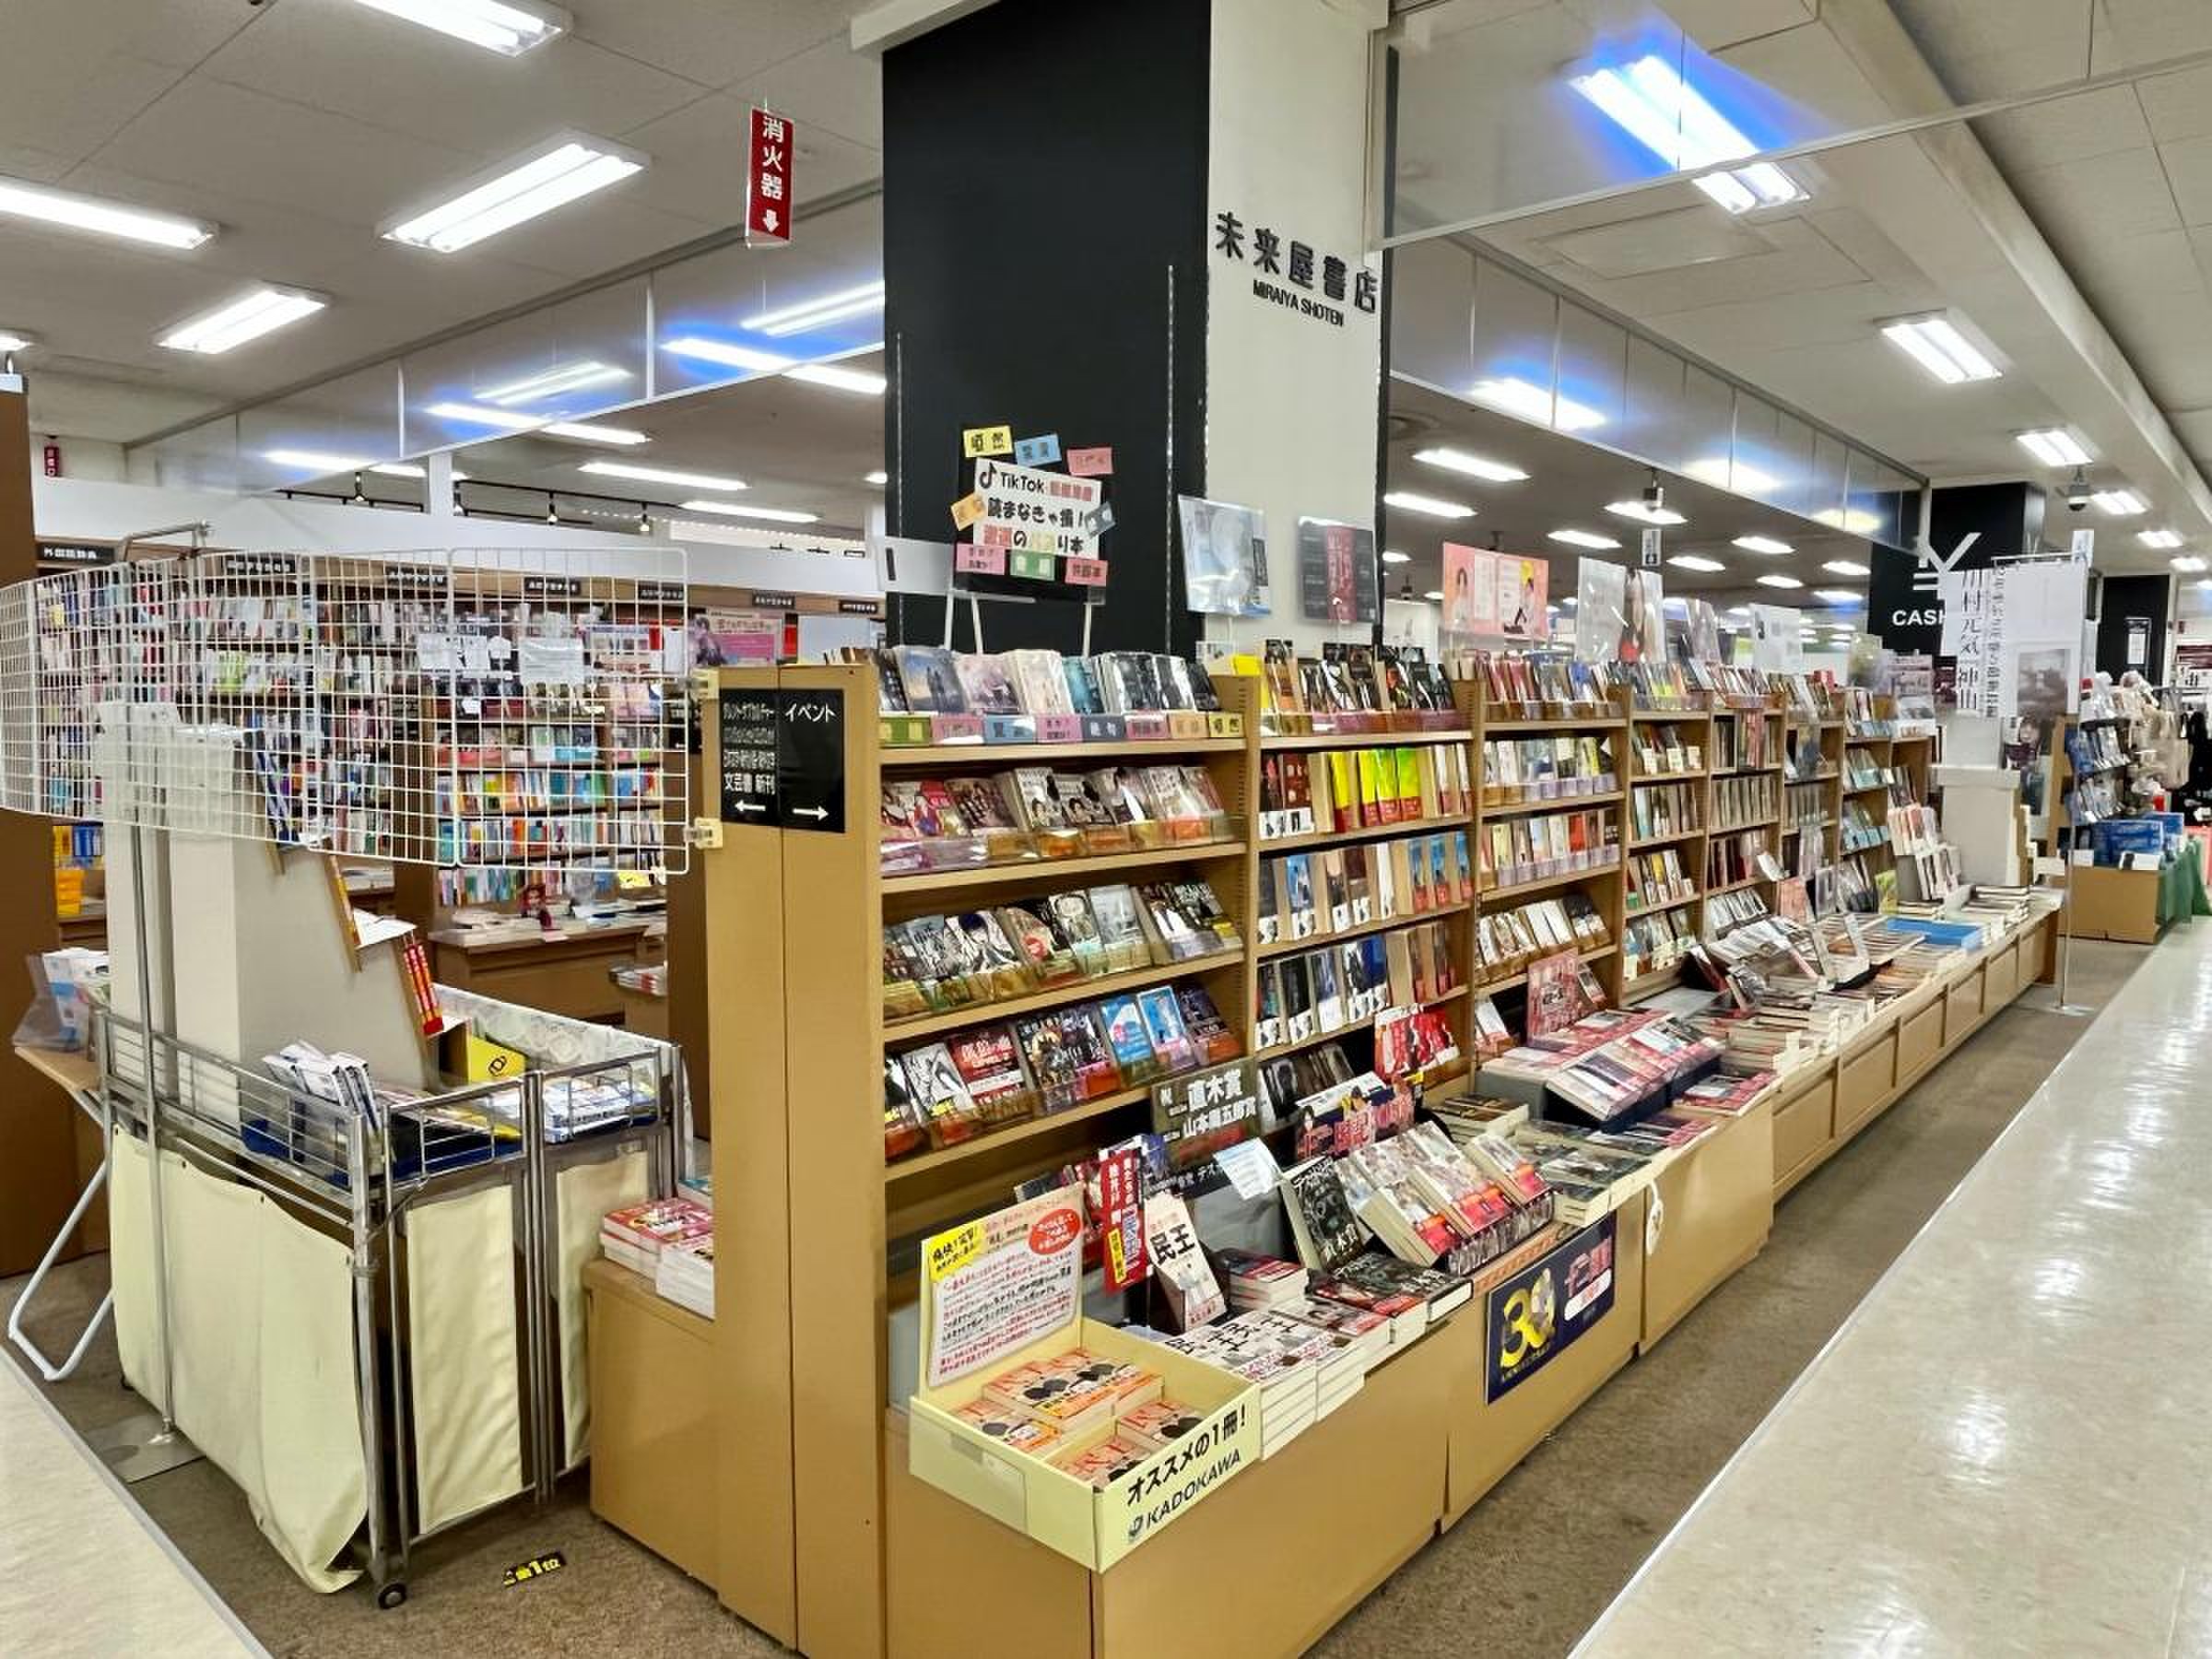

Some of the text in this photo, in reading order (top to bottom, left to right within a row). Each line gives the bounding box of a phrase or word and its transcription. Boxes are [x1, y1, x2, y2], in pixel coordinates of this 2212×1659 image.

[762, 115, 783, 201] 消火器
[1216, 212, 1377, 313] 未来屋書店
[1253, 280, 1344, 326] MIRAIYA SHOTEN
[1001, 472, 1045, 493] TikTok
[785, 703, 837, 723] イベント
[1147, 1449, 1241, 1528] KADOKAWA
